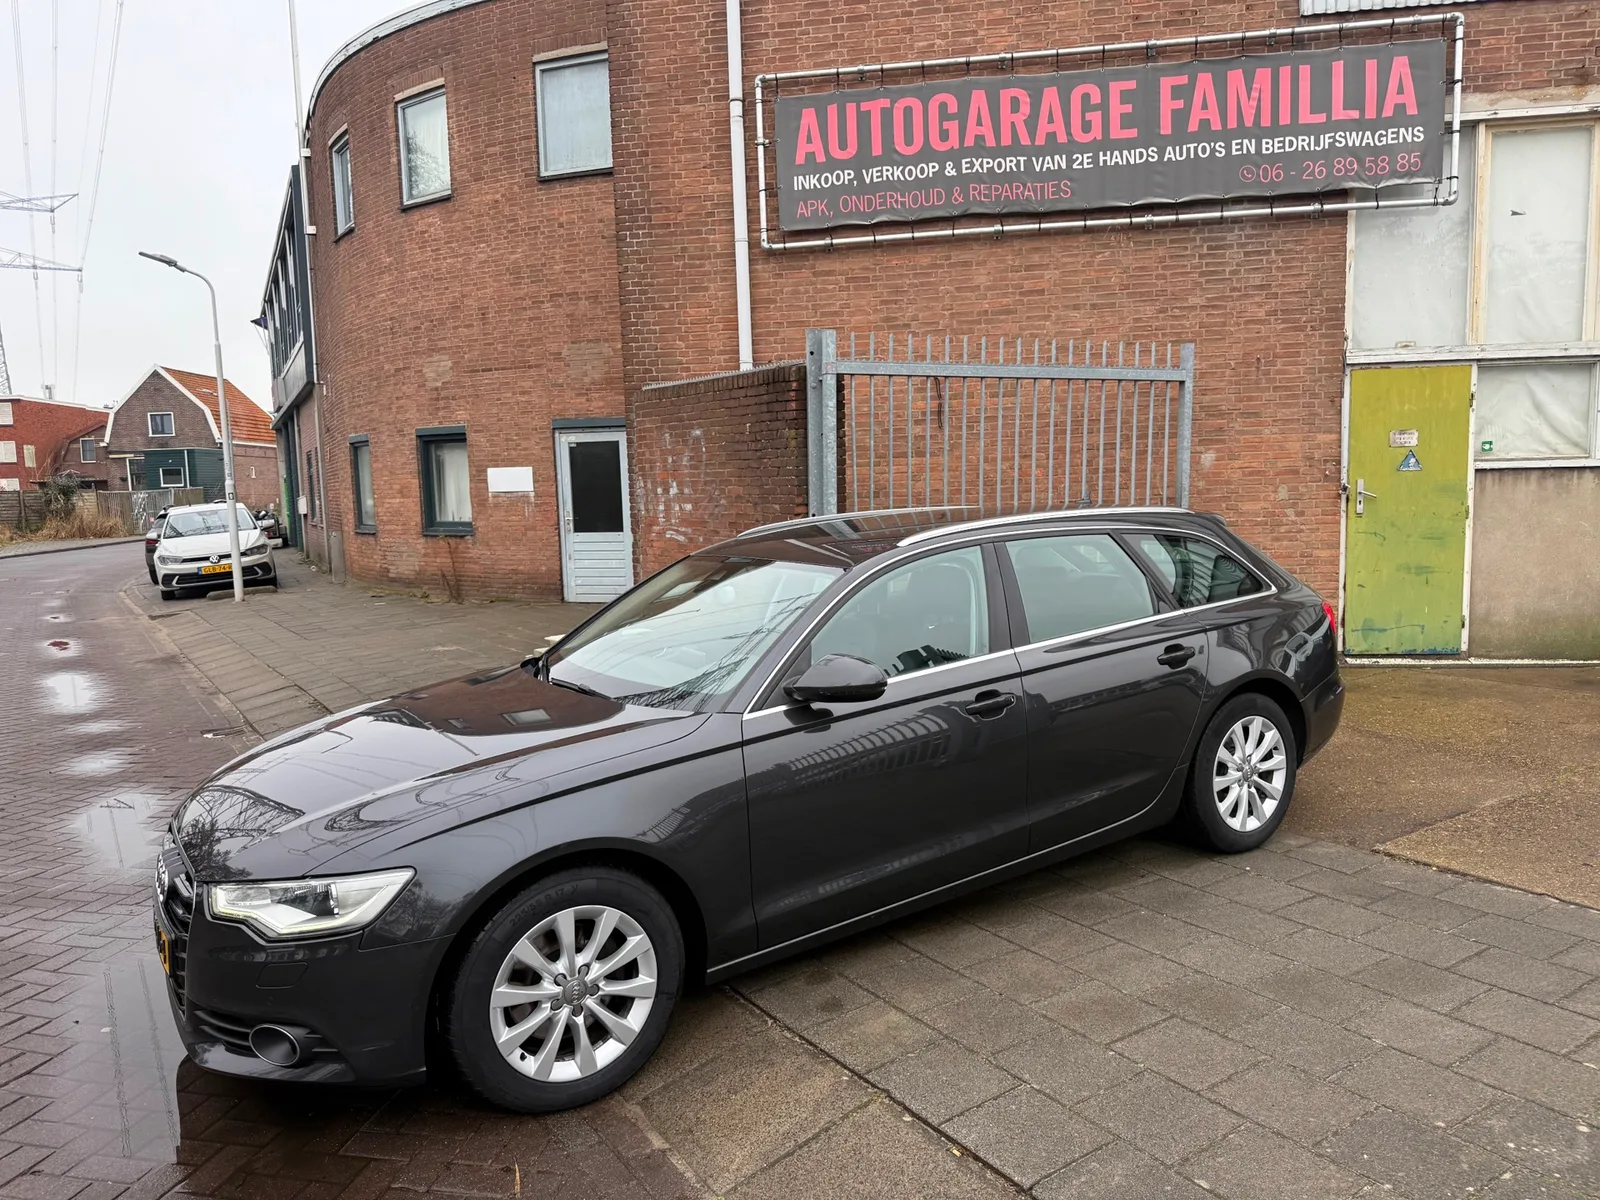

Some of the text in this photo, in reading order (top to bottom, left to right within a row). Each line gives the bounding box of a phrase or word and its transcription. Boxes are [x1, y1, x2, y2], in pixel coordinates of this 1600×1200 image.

[795, 56, 1418, 165] AUTOGARAGE FAMILLIA
[794, 126, 1424, 190] INKOOP, VERKOOP & EXPORT VAN 2E HANDS AUTO'S EN BEDRIJFSWAGENS
[1259, 162, 1284, 183] 06
[1302, 161, 1327, 180] 26
[1334, 157, 1358, 177] 89
[1364, 156, 1390, 176] 58
[1396, 152, 1422, 172] 85
[798, 180, 1072, 217] APK, ONDERHOUD & REPARATIES
